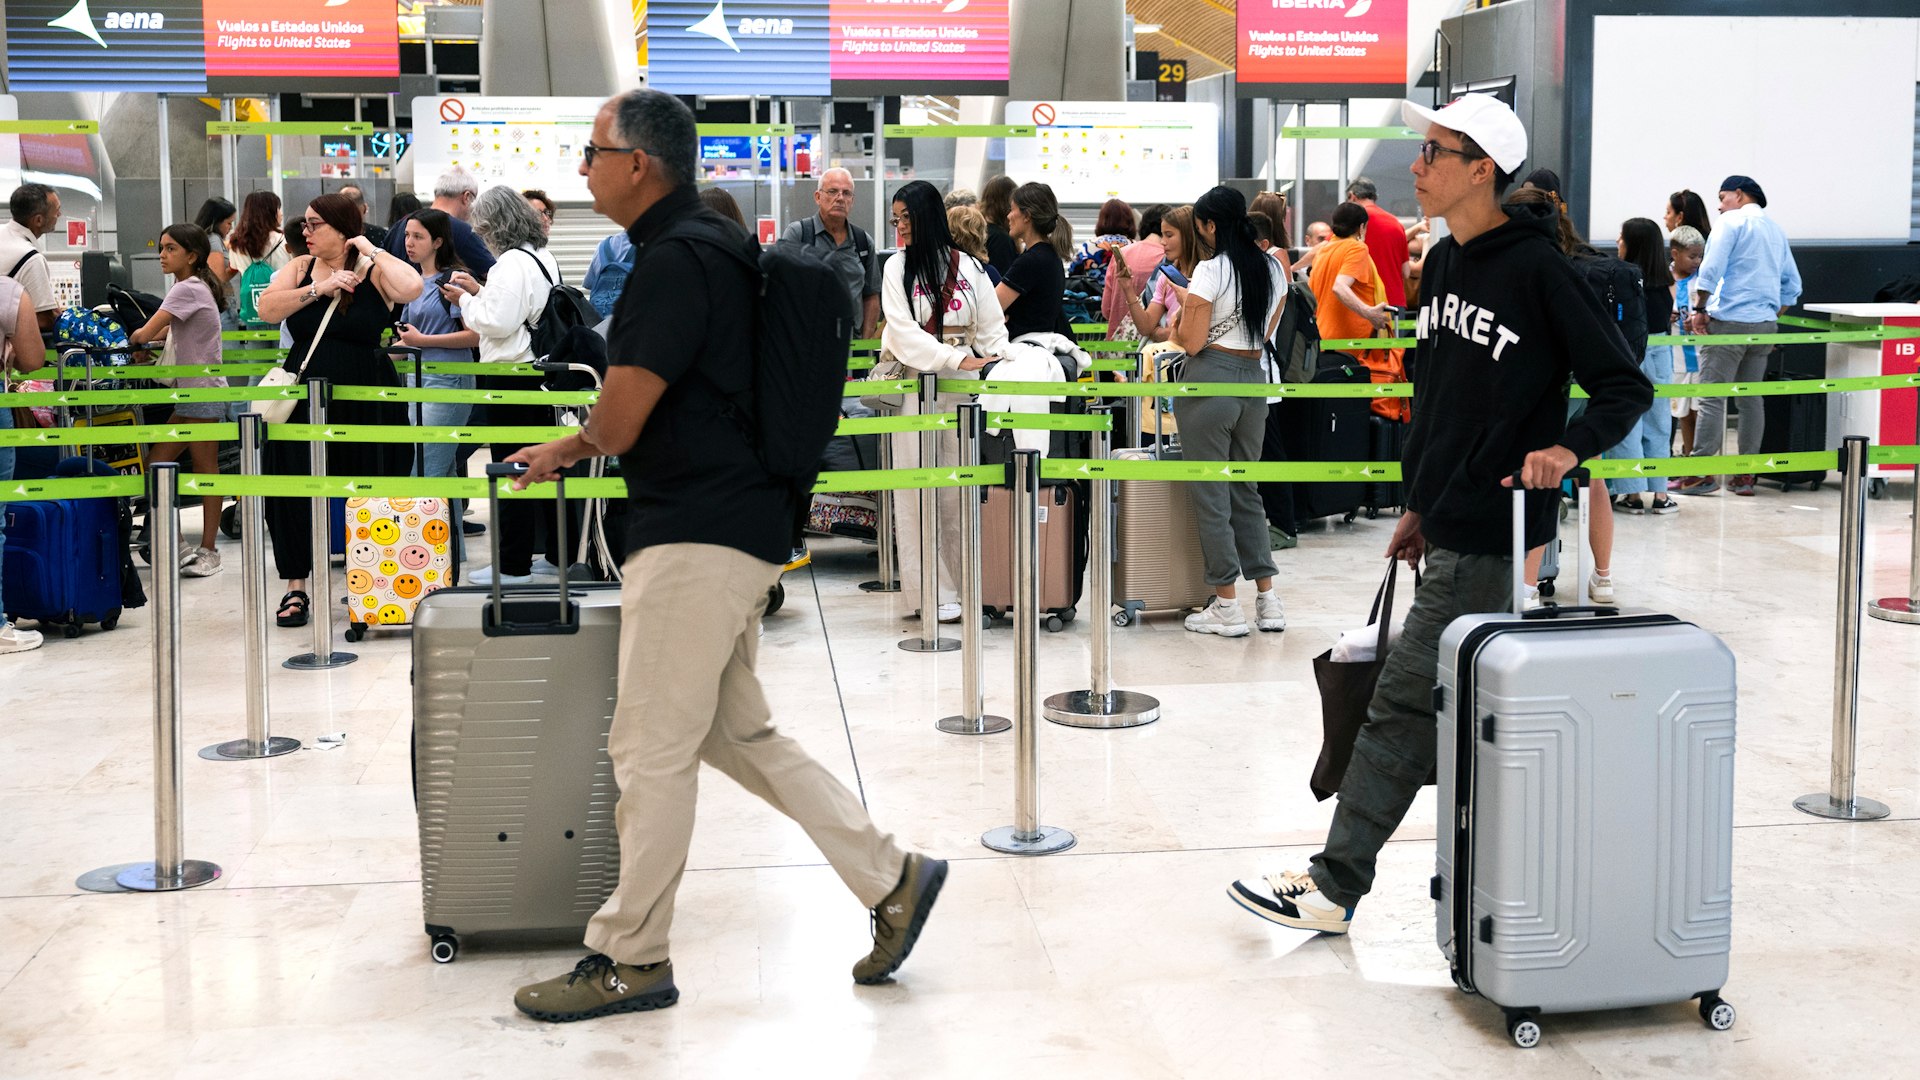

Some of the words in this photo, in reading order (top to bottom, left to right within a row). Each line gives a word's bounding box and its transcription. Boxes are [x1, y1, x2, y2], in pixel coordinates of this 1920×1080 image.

[104, 12, 164, 29] aena
[217, 20, 259, 33] Vuelos
[261, 23, 269, 33] a
[271, 20, 320, 33] Estados
[321, 20, 364, 34] Unidos
[738, 17, 793, 35] aena
[842, 26, 881, 38] Vuelos
[882, 28, 890, 38] a
[892, 26, 937, 38] Estados
[939, 26, 979, 39] Unidos
[1249, 30, 1287, 42] Vuelos
[1287, 33, 1296, 42] a
[1296, 31, 1340, 43] Estados
[1340, 31, 1379, 43] Unidos
[217, 35, 257, 51] Flights
[259, 37, 271, 48] to
[274, 36, 312, 48] United
[314, 37, 351, 49] States
[842, 40, 879, 55] Flights
[880, 41, 893, 52] to
[893, 41, 931, 53] United
[931, 41, 966, 53] States
[1249, 44, 1284, 58] Flights
[1285, 46, 1297, 57] to
[1298, 45, 1334, 57] United
[1334, 45, 1367, 57] States
[1159, 63, 1185, 83] 29
[1416, 293, 1520, 361] MARKET
[1895, 343, 1916, 356] IB
[393, 515, 400, 523] it
